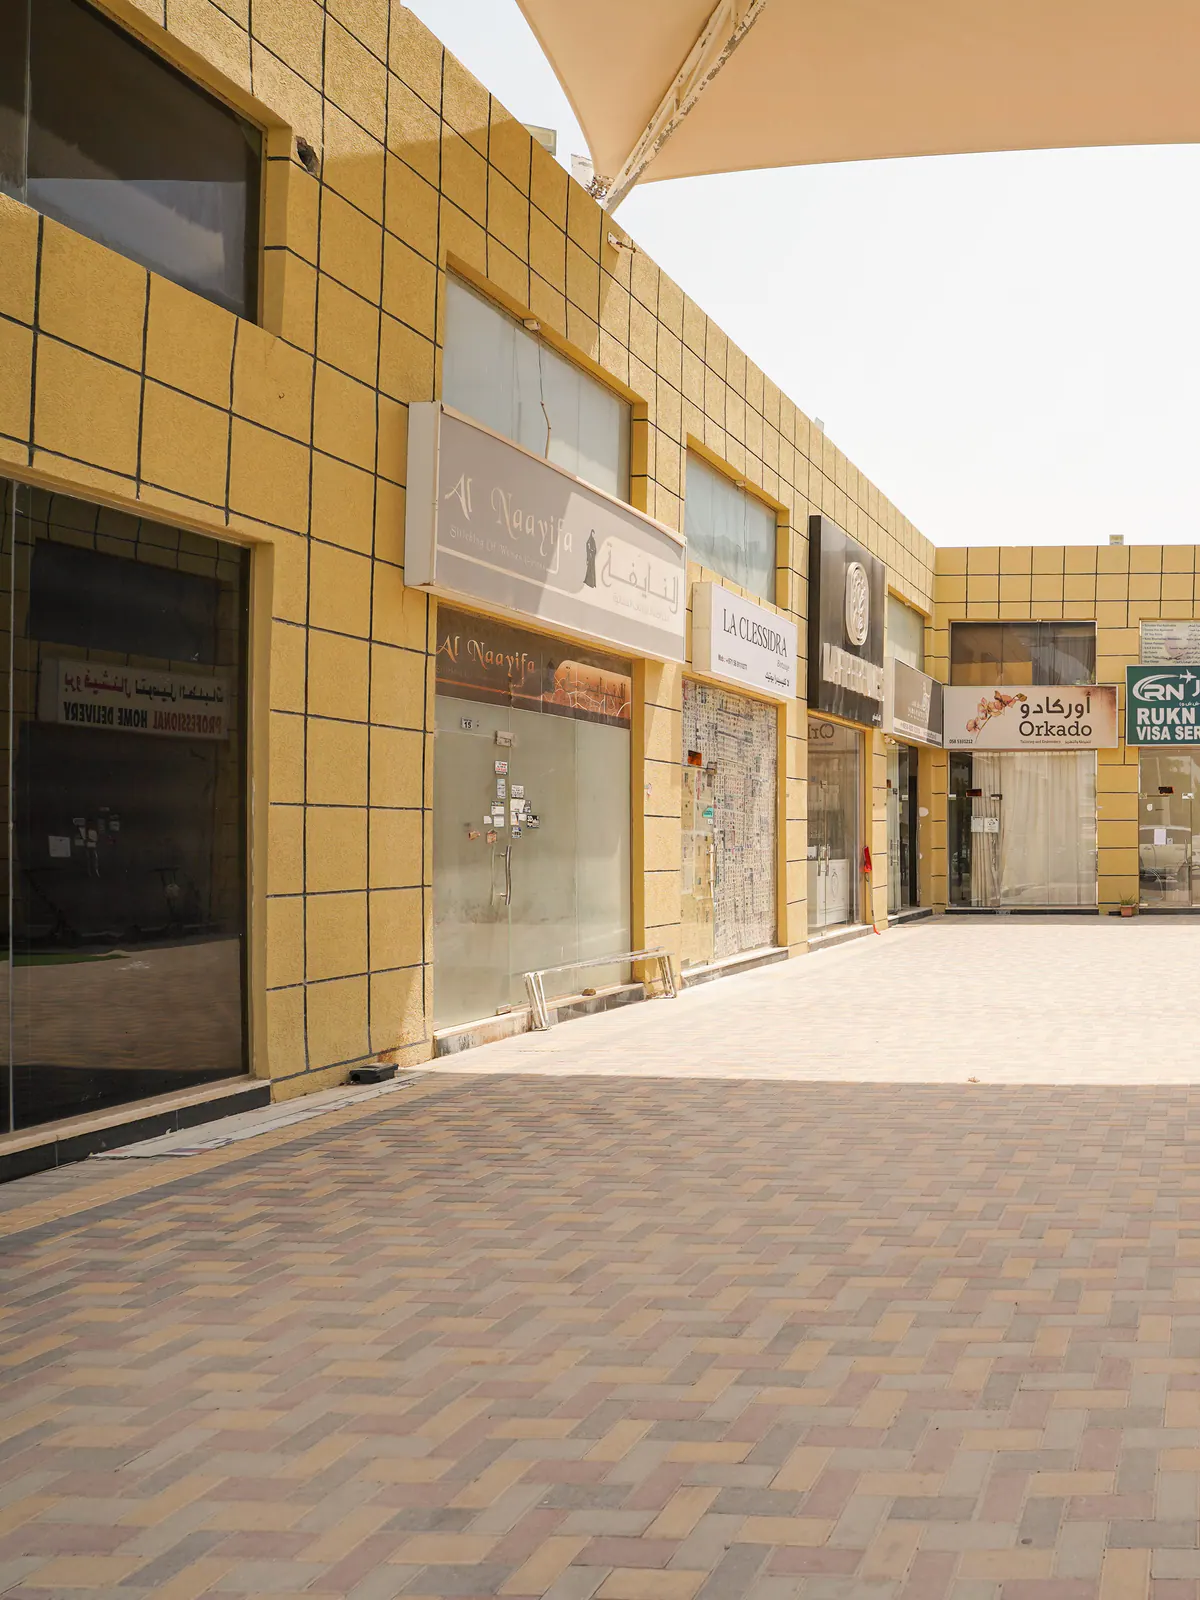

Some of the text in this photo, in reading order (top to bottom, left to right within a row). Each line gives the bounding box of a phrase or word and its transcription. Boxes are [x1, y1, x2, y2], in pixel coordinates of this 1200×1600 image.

[445, 472, 573, 574] Al Naayifa
[723, 608, 788, 658] LA CLESSIDRA
[436, 635, 461, 664] Al
[467, 639, 536, 688] Naayifa
[1020, 691, 1091, 719] أوركادو
[1136, 707, 1196, 725] RUKN
[464, 721, 472, 729] 15
[1019, 721, 1092, 737] Orkado
[1136, 726, 1171, 740] VISA
